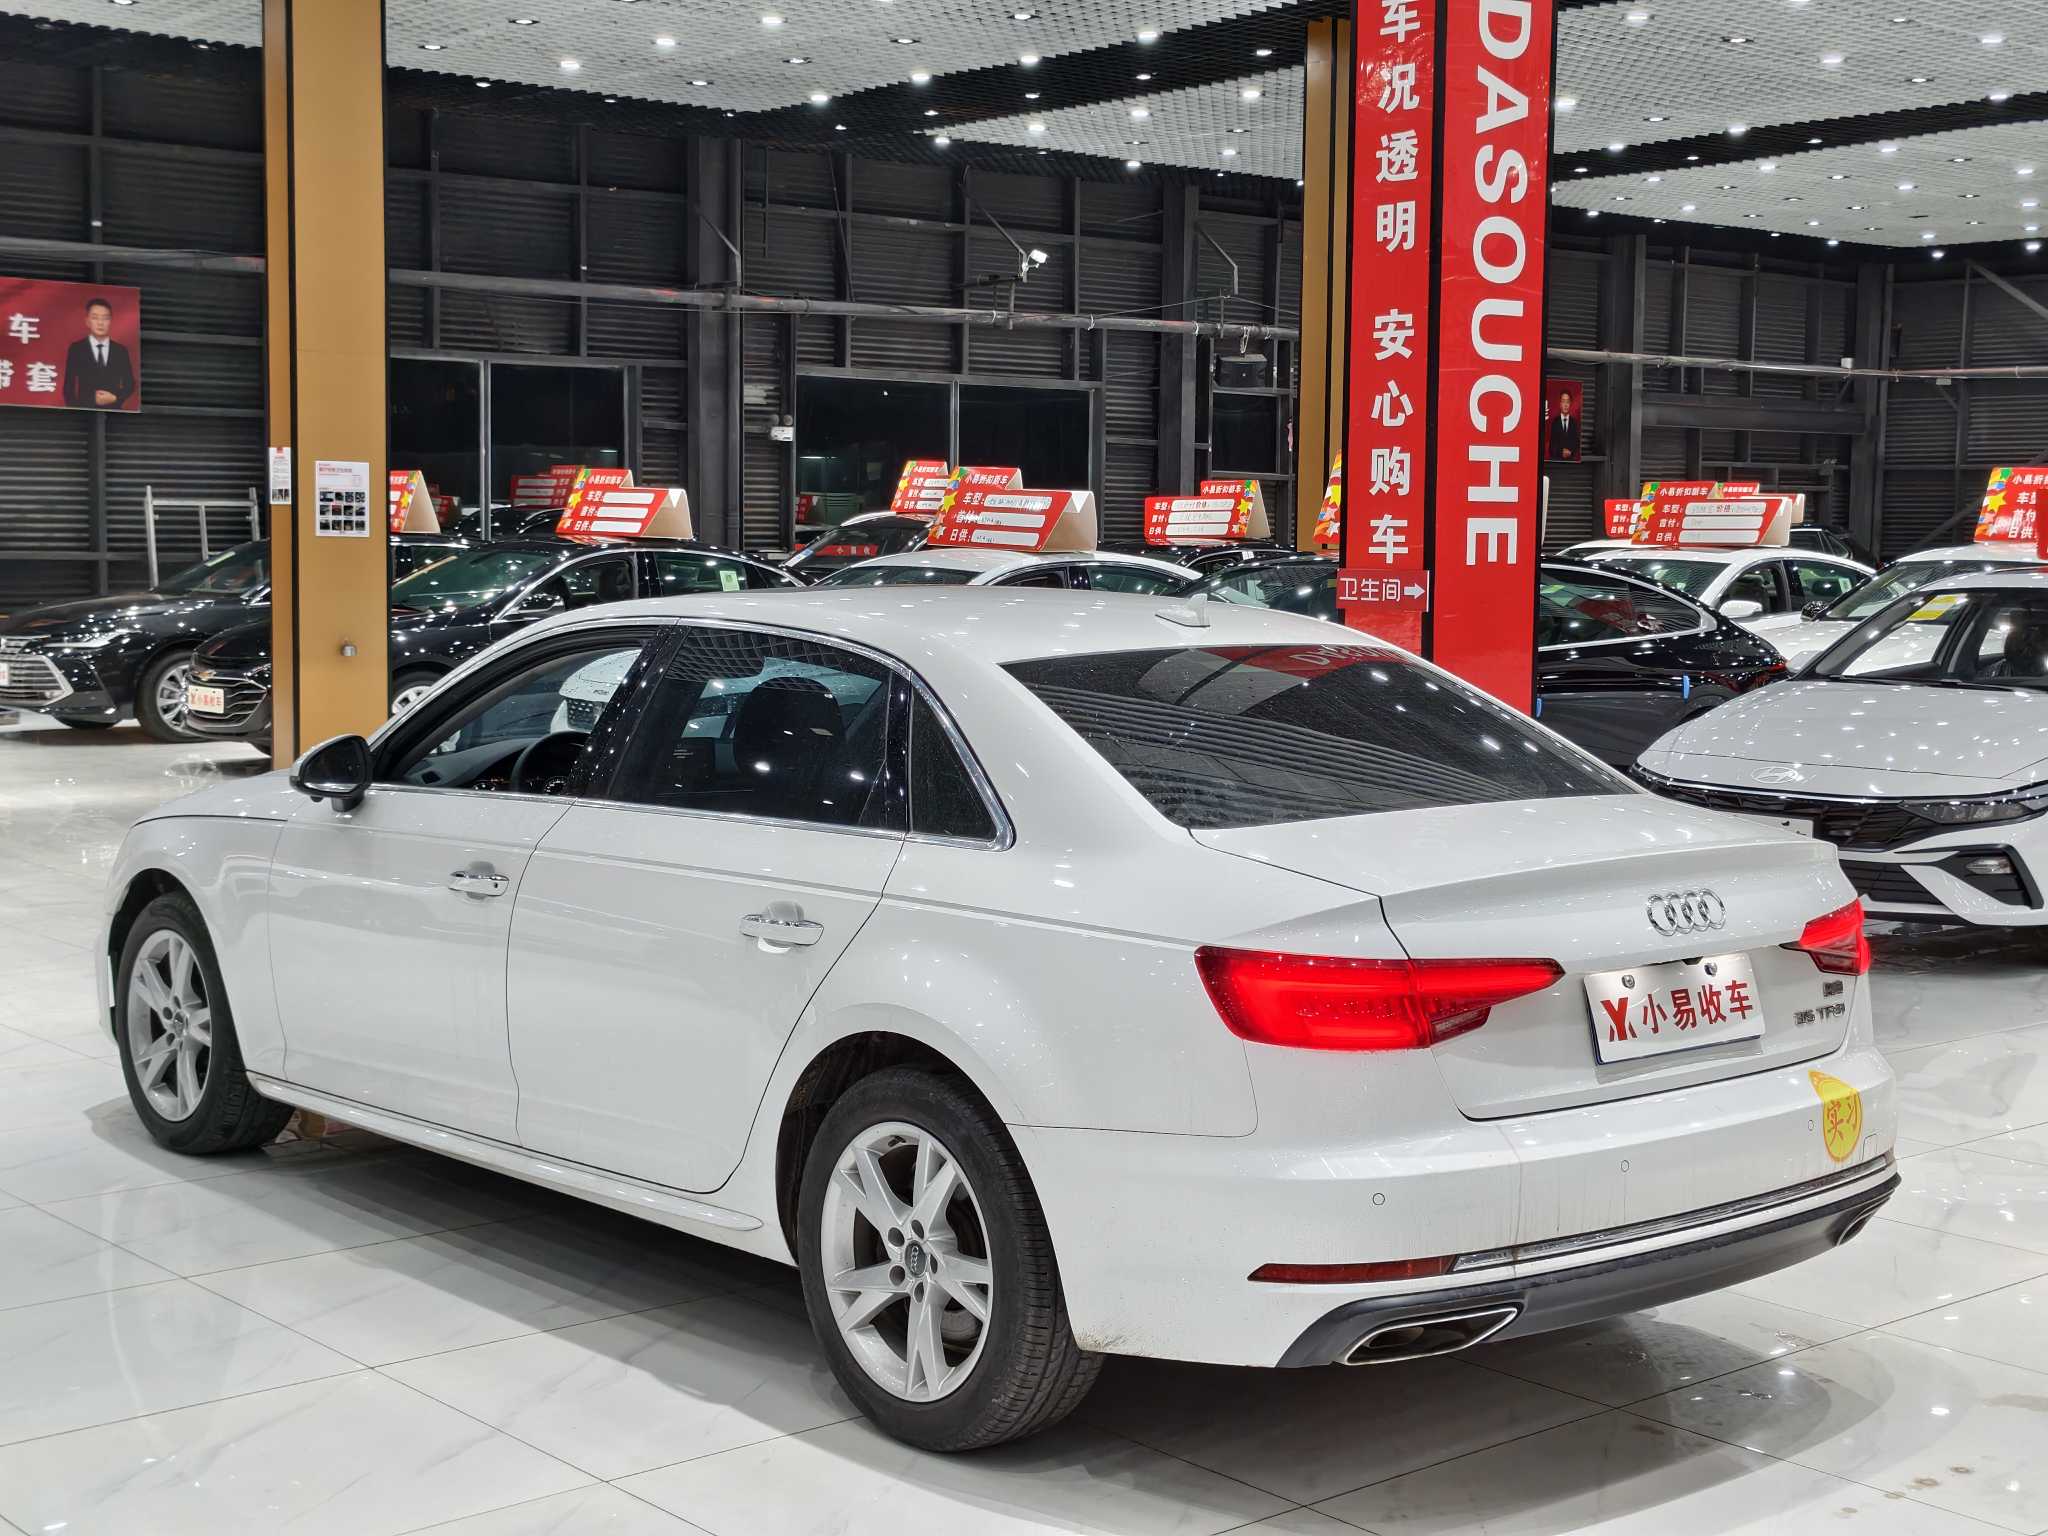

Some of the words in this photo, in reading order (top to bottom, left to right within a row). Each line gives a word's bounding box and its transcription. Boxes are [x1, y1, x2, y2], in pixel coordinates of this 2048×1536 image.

[1376, 0, 1420, 252] 车况透明
[8, 313, 40, 344] 车
[1466, 0, 1532, 565] DASOUCHE
[1368, 308, 1415, 564] 安心购车
[1339, 578, 1401, 601] 卫生间
[1643, 979, 1753, 1034] 小易收车
